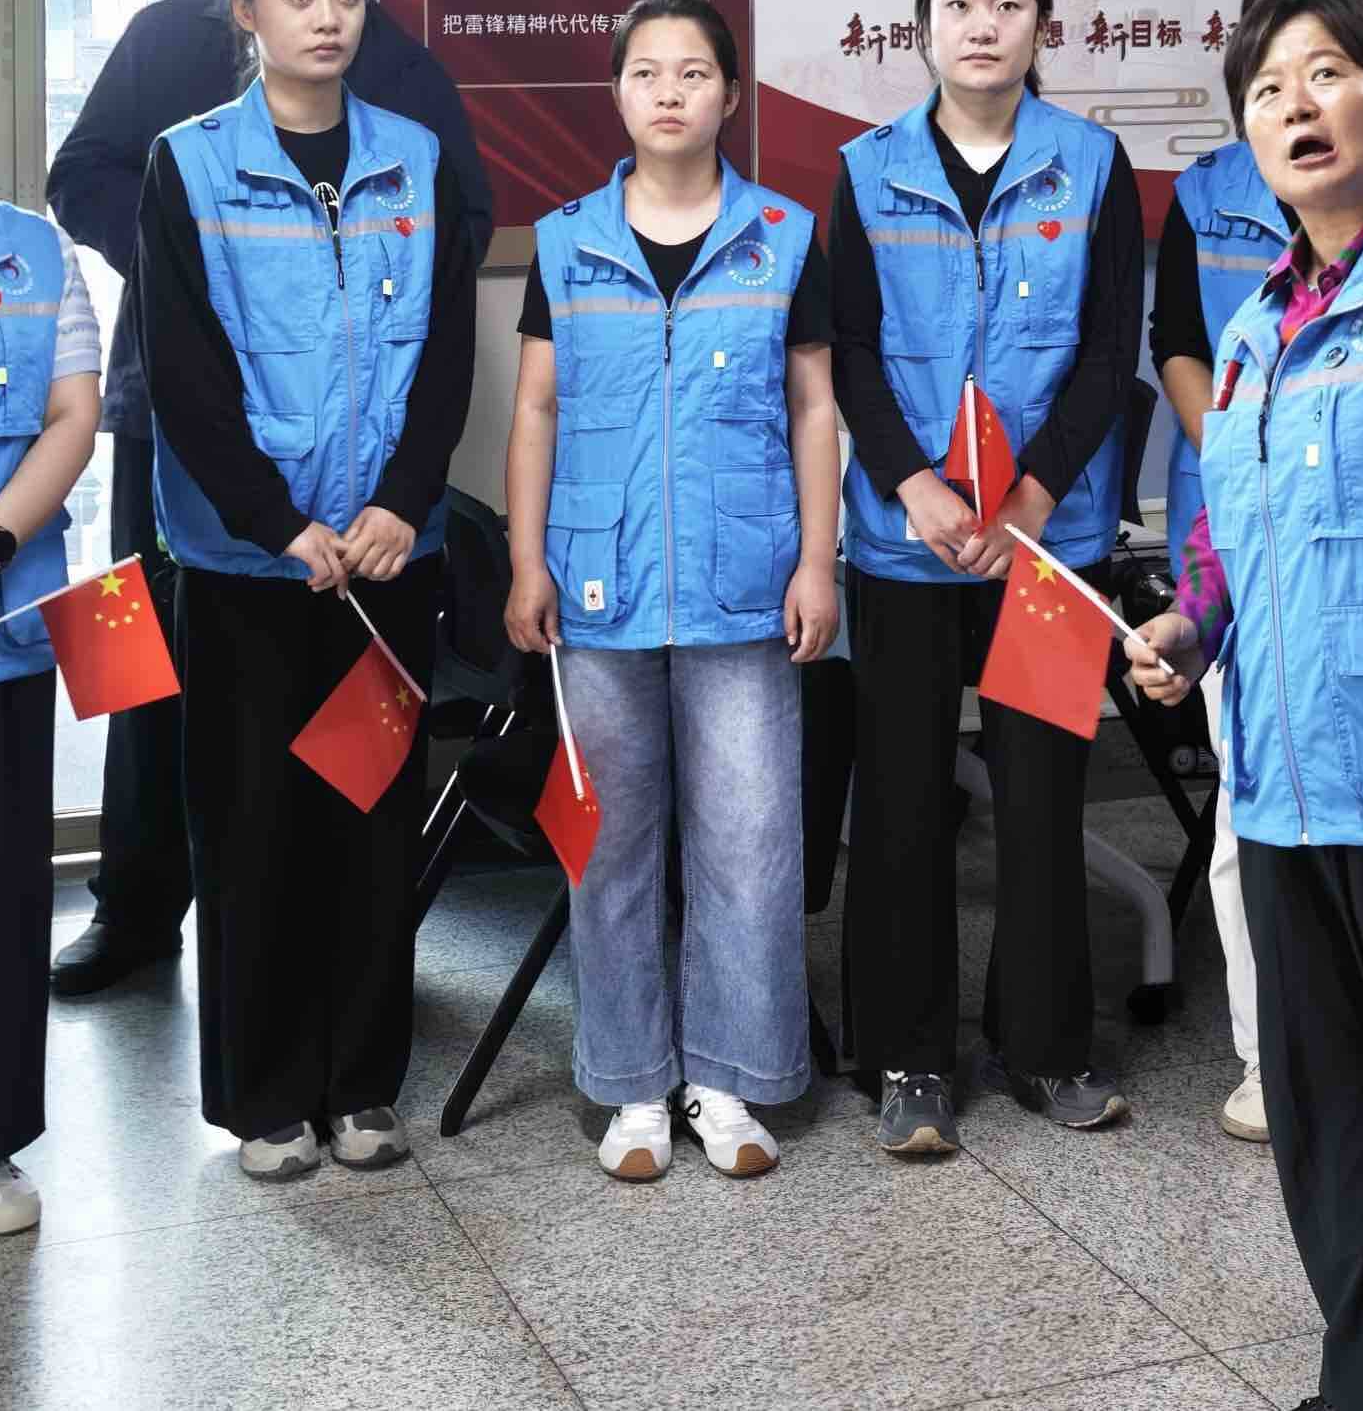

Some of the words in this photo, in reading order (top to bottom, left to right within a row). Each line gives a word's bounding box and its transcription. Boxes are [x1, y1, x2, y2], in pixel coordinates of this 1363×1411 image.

[840, 12, 914, 66] 新时
[1085, 10, 1183, 62] 新目标
